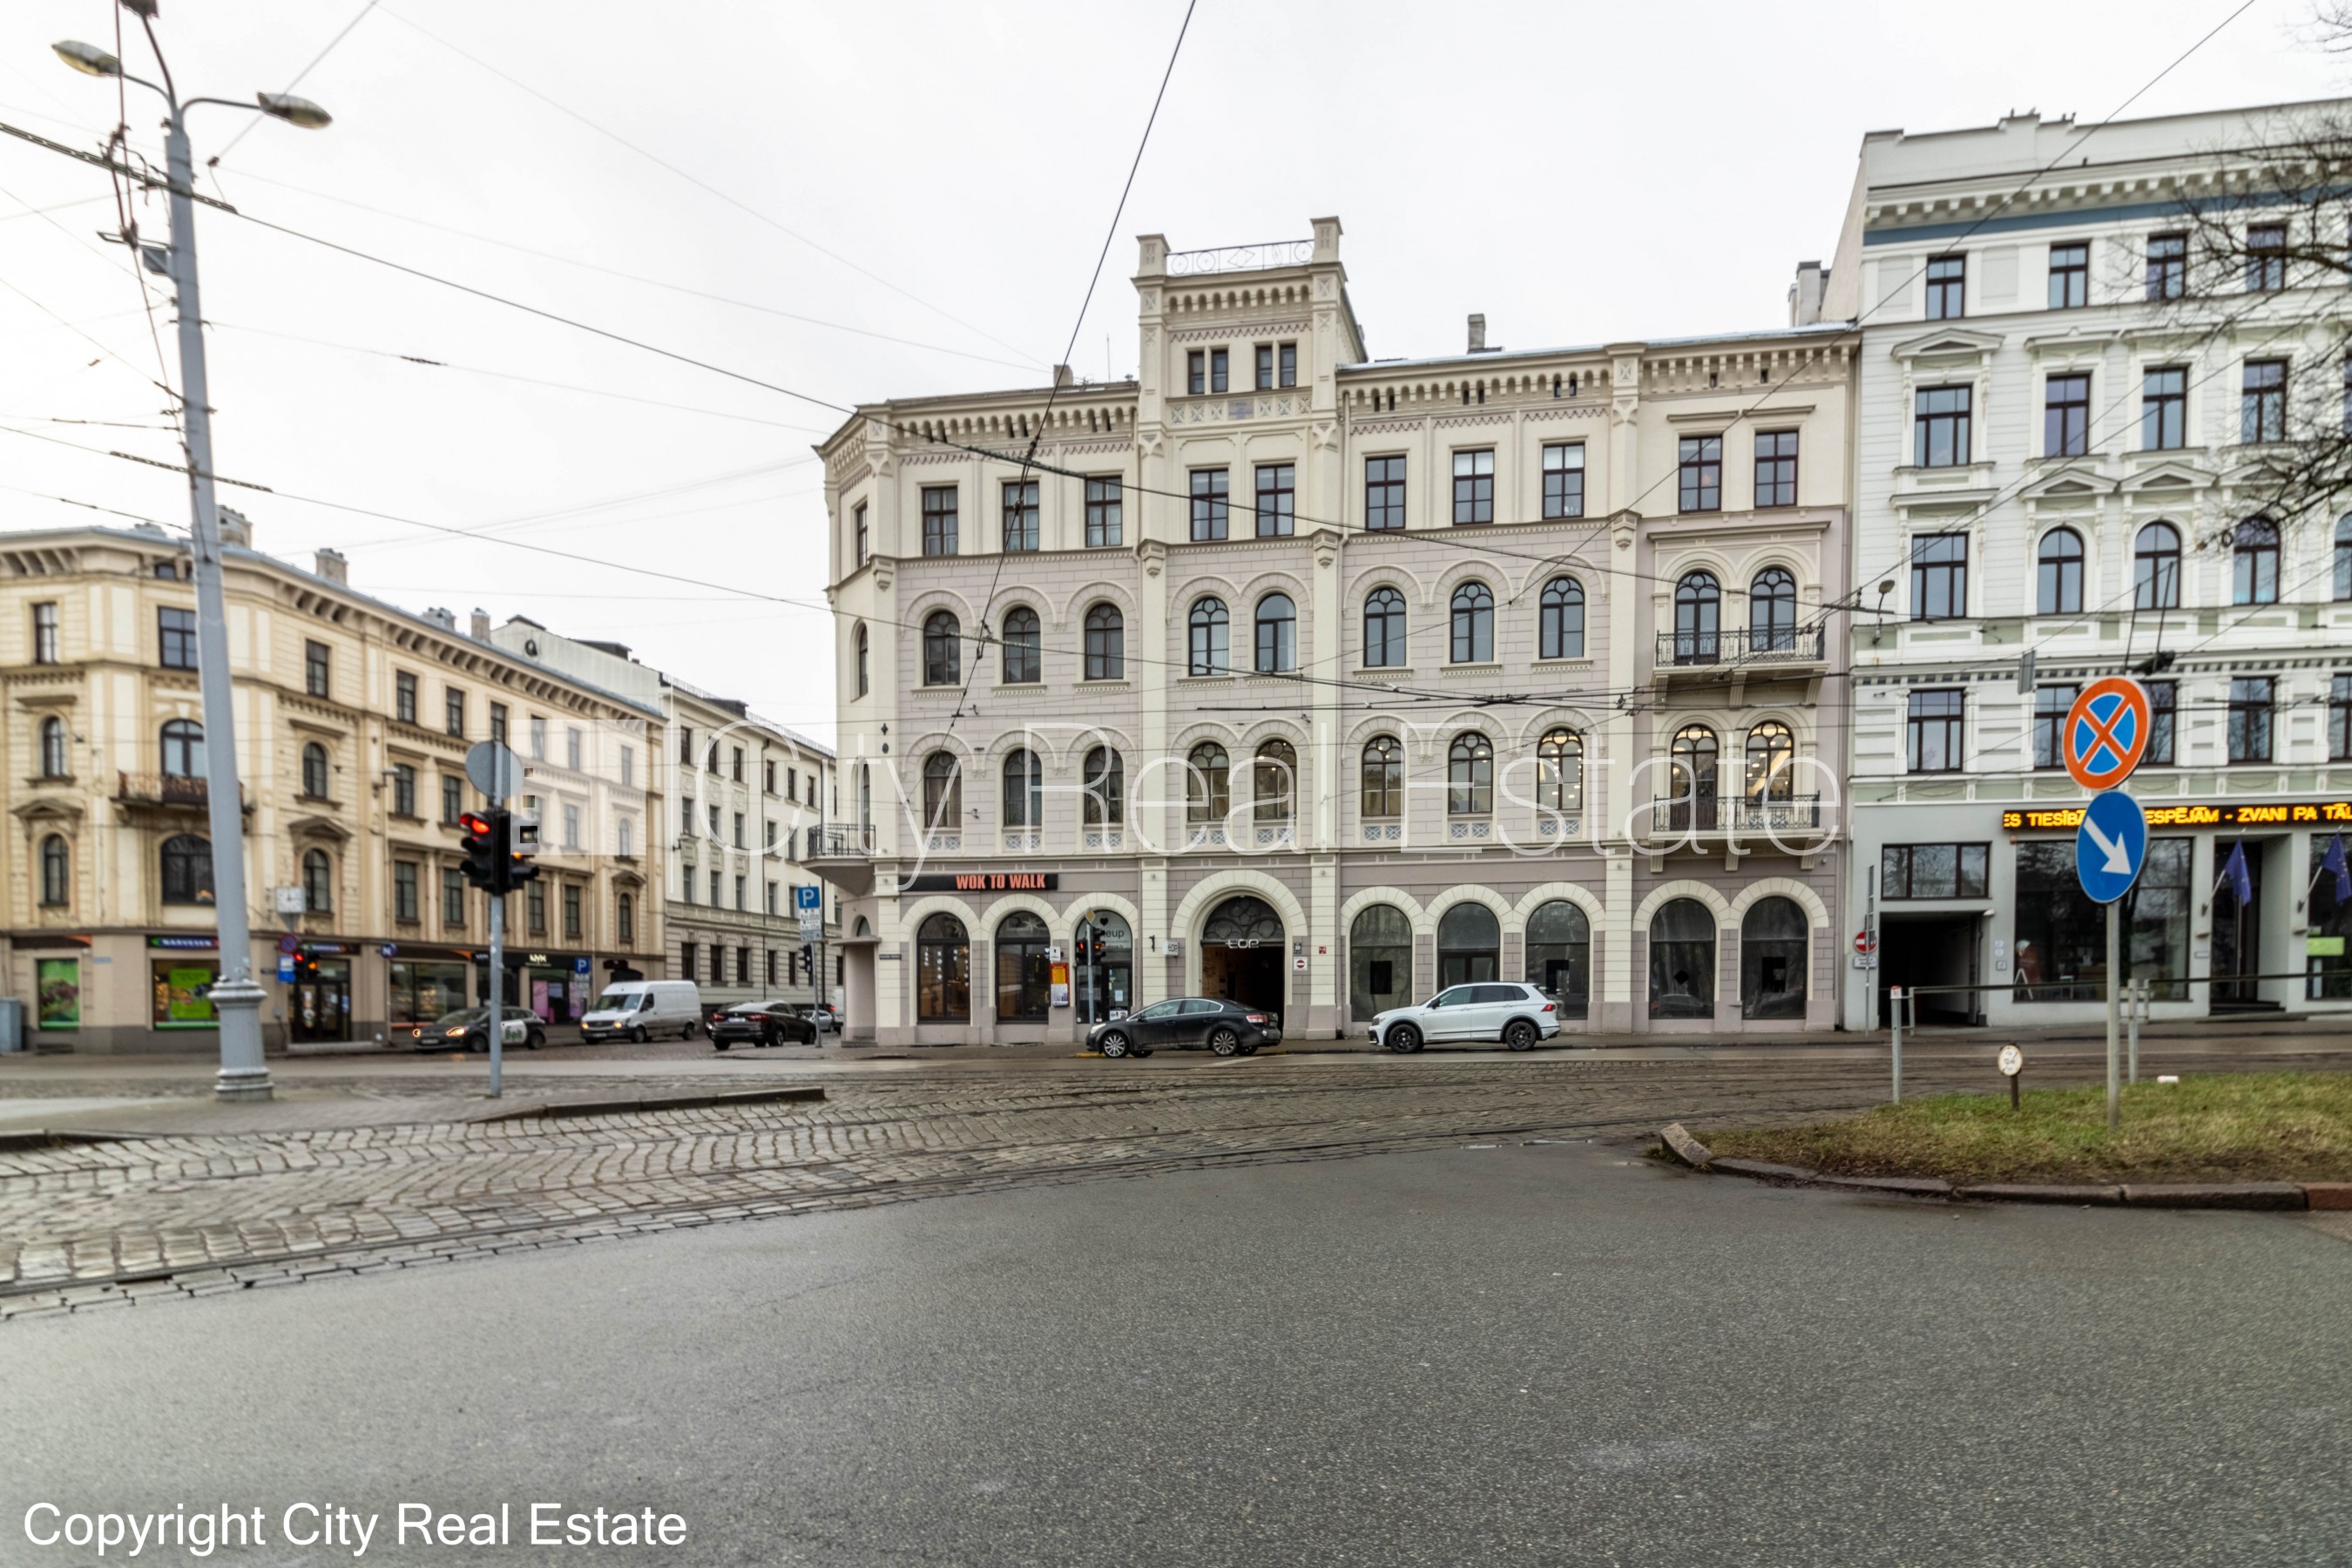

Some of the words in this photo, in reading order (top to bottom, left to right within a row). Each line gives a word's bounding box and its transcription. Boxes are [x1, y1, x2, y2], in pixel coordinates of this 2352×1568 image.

[2237, 808, 2287, 823] ZVANI
[2294, 806, 2318, 821] PA
[956, 874, 986, 889] WOK
[990, 875, 1005, 889] TO
[1009, 874, 1046, 889] WALK
[802, 889, 814, 907] P
[578, 959, 587, 972] P
[505, 1028, 523, 1040] Bolt
